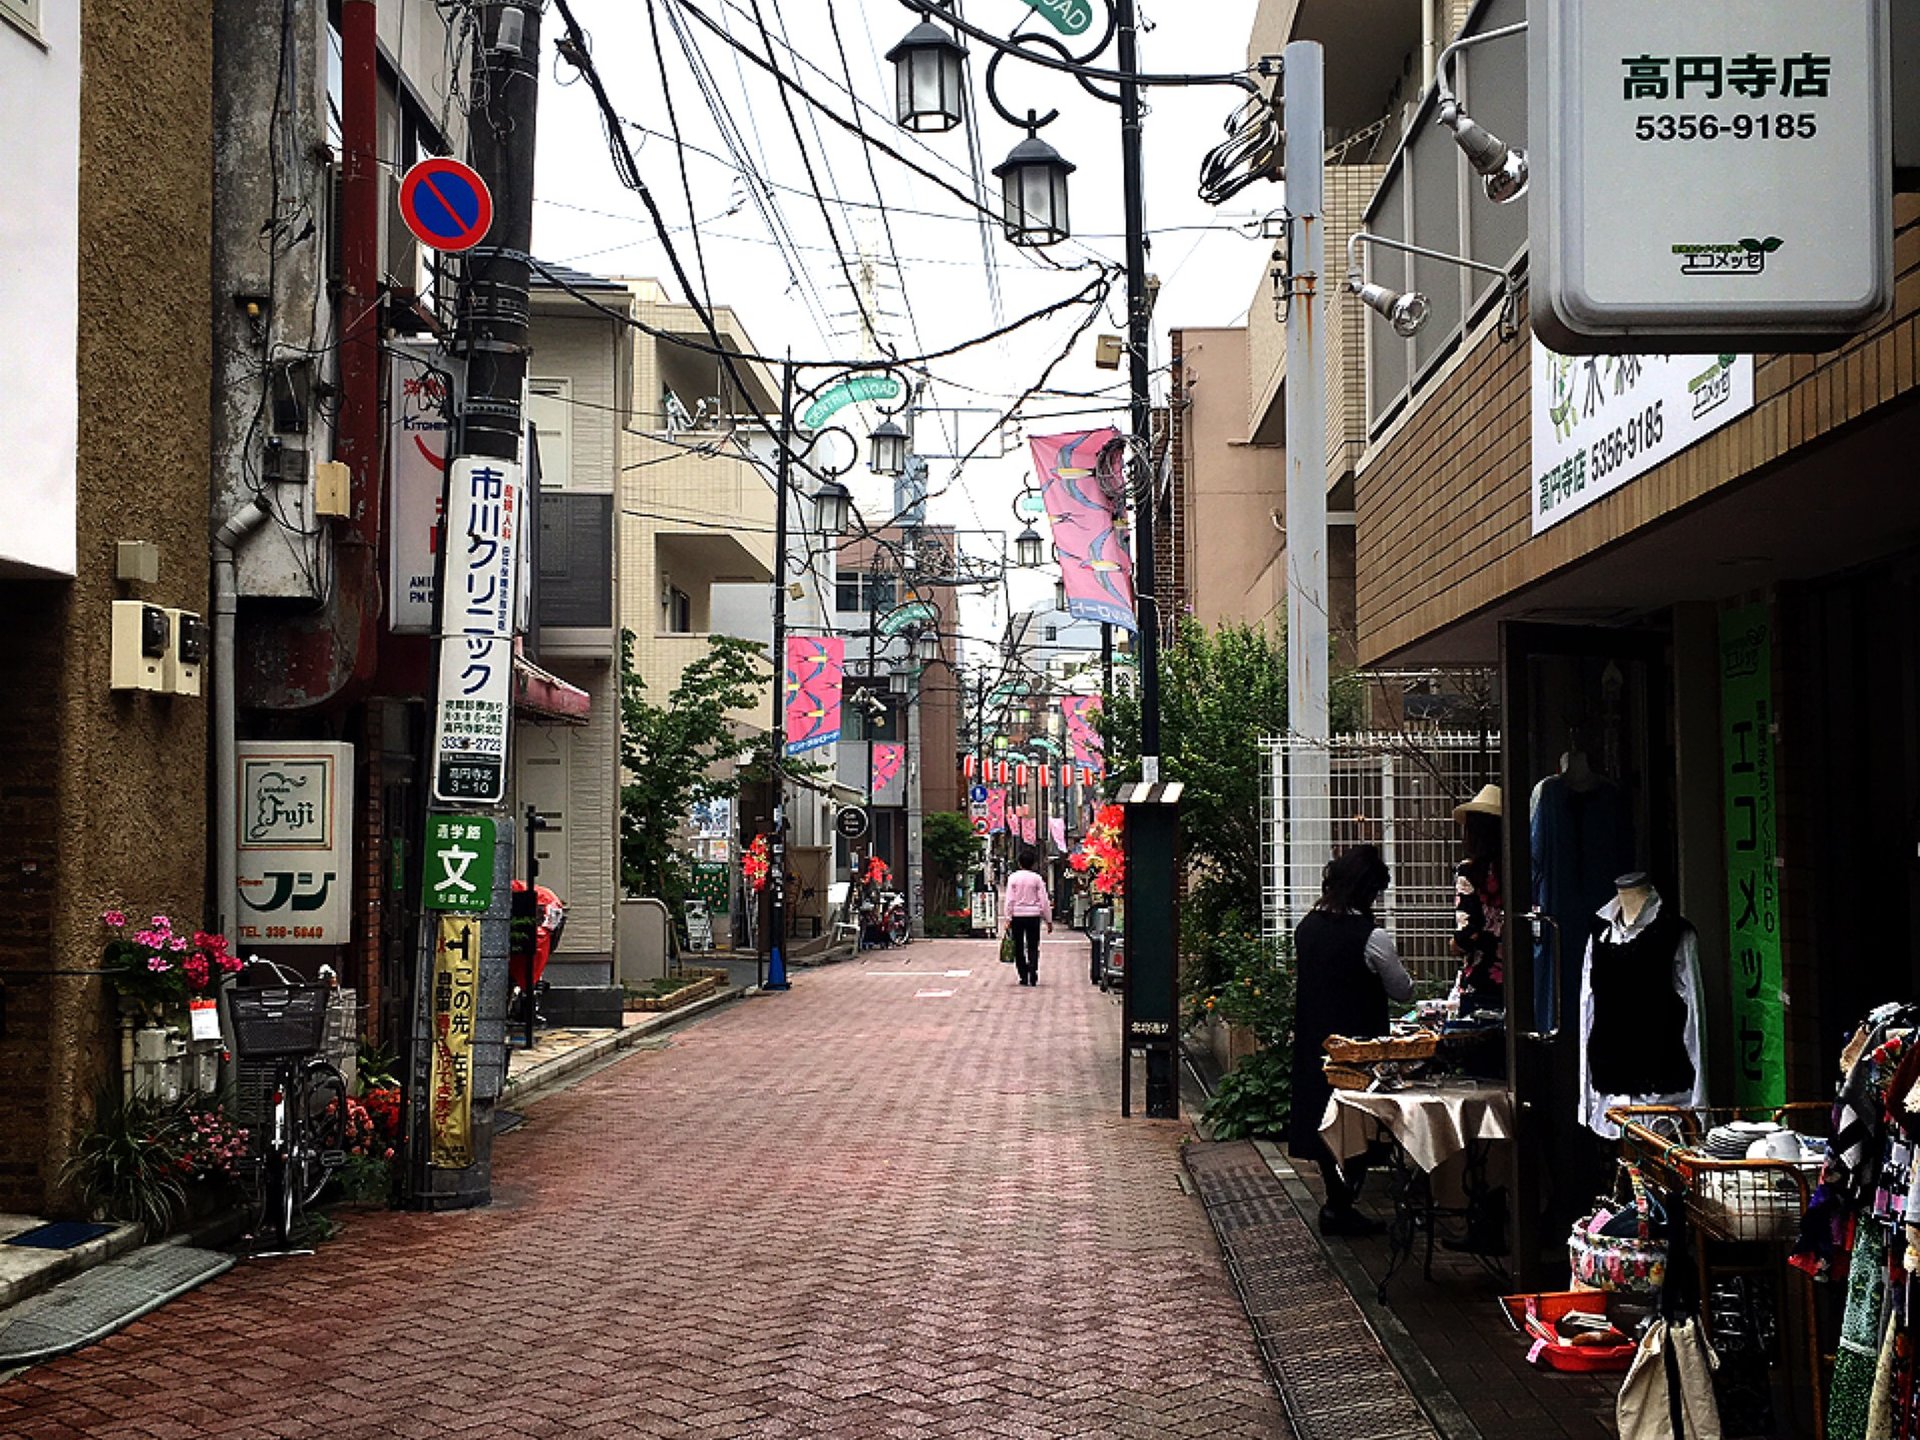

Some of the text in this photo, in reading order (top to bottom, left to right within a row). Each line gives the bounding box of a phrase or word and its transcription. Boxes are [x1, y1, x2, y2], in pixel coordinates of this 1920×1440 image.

[1621, 52, 1831, 100] 高円寺店
[1635, 113, 1818, 140] 5356-9185
[1682, 253, 1761, 269] エコメッセ
[1539, 398, 1663, 515] 高円寺店 5356-9185
[461, 467, 504, 694] 市川クリニック
[441, 736, 502, 751] 333-2723
[449, 767, 492, 781] 高円寺北
[266, 794, 314, 830] Fuji
[437, 823, 481, 840] 通学路
[434, 844, 478, 892] 文
[1731, 721, 1766, 1083] エコメッセ
[239, 926, 262, 938] TEL
